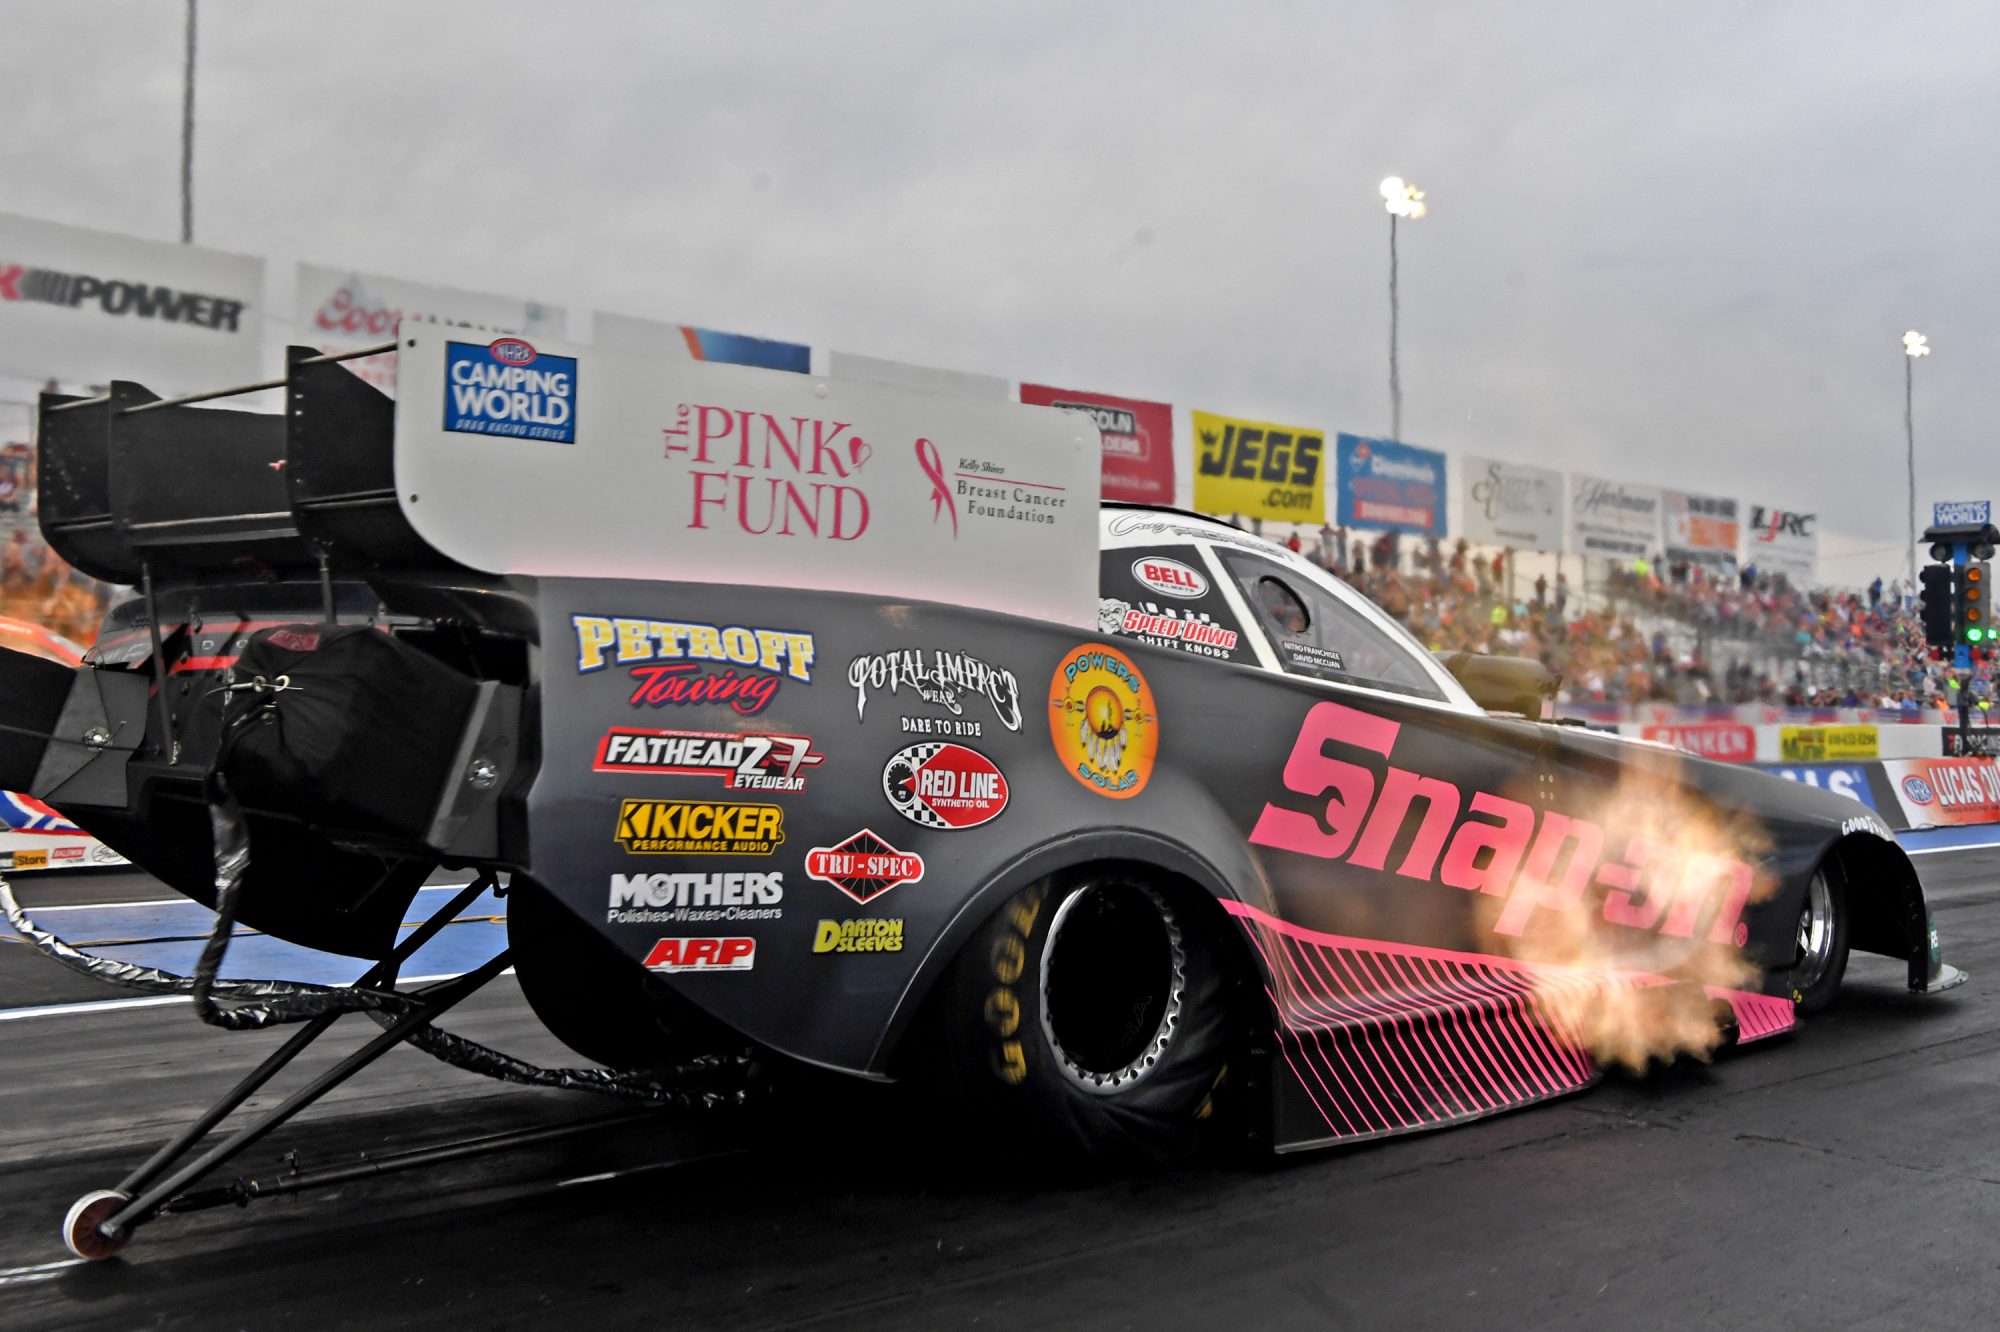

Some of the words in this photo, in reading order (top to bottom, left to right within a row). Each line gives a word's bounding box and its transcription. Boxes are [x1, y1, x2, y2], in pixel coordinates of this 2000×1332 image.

[74, 275, 243, 333] POWER
[451, 359, 570, 398] CAMPING
[451, 384, 570, 425] WORLD
[455, 418, 486, 432] DRAG
[487, 422, 527, 436] RACING
[529, 426, 566, 440] SERIES
[662, 403, 690, 460] The
[691, 404, 853, 479] PINK
[959, 457, 980, 472] Kelly
[1200, 424, 1322, 486] JEGS
[687, 470, 871, 541] FUND
[957, 480, 1007, 501] Breast
[1013, 488, 1067, 508] Cancer
[1261, 488, 1314, 510] .com
[967, 500, 1056, 525] Foundation
[1936, 511, 1988, 526] WORLD
[1143, 563, 1199, 589] BELL
[1124, 610, 1182, 638] SPEED
[1181, 617, 1238, 651] DAWG
[1136, 634, 1179, 649] SHIFT
[1184, 642, 1231, 659] KNOBS
[570, 614, 816, 682] PETROFF
[1064, 651, 1140, 693] POWERS
[629, 664, 780, 717] Towing
[848, 649, 931, 724] TOTAL
[929, 650, 1023, 732] IMPACT
[902, 716, 932, 733] DARE
[934, 720, 952, 734] TO
[954, 721, 982, 737] RIDE
[733, 774, 805, 791] EYEWEAR
[920, 768, 956, 796] RED
[960, 771, 1000, 800] LINE
[1077, 762, 1140, 791] SOLAR
[1905, 777, 1932, 803] NHRA
[1928, 766, 1985, 806] LUCAS
[931, 797, 974, 808] SYNTHETIC
[976, 800, 990, 809] OIL
[651, 803, 781, 839] KICKER
[632, 840, 728, 851] PERFORMANCE
[732, 842, 770, 852] AUDIO
[608, 871, 784, 909] MOTHERS
[813, 918, 903, 953] DARTON
[835, 936, 903, 952] SLEEVES
[643, 938, 754, 966] ARP
